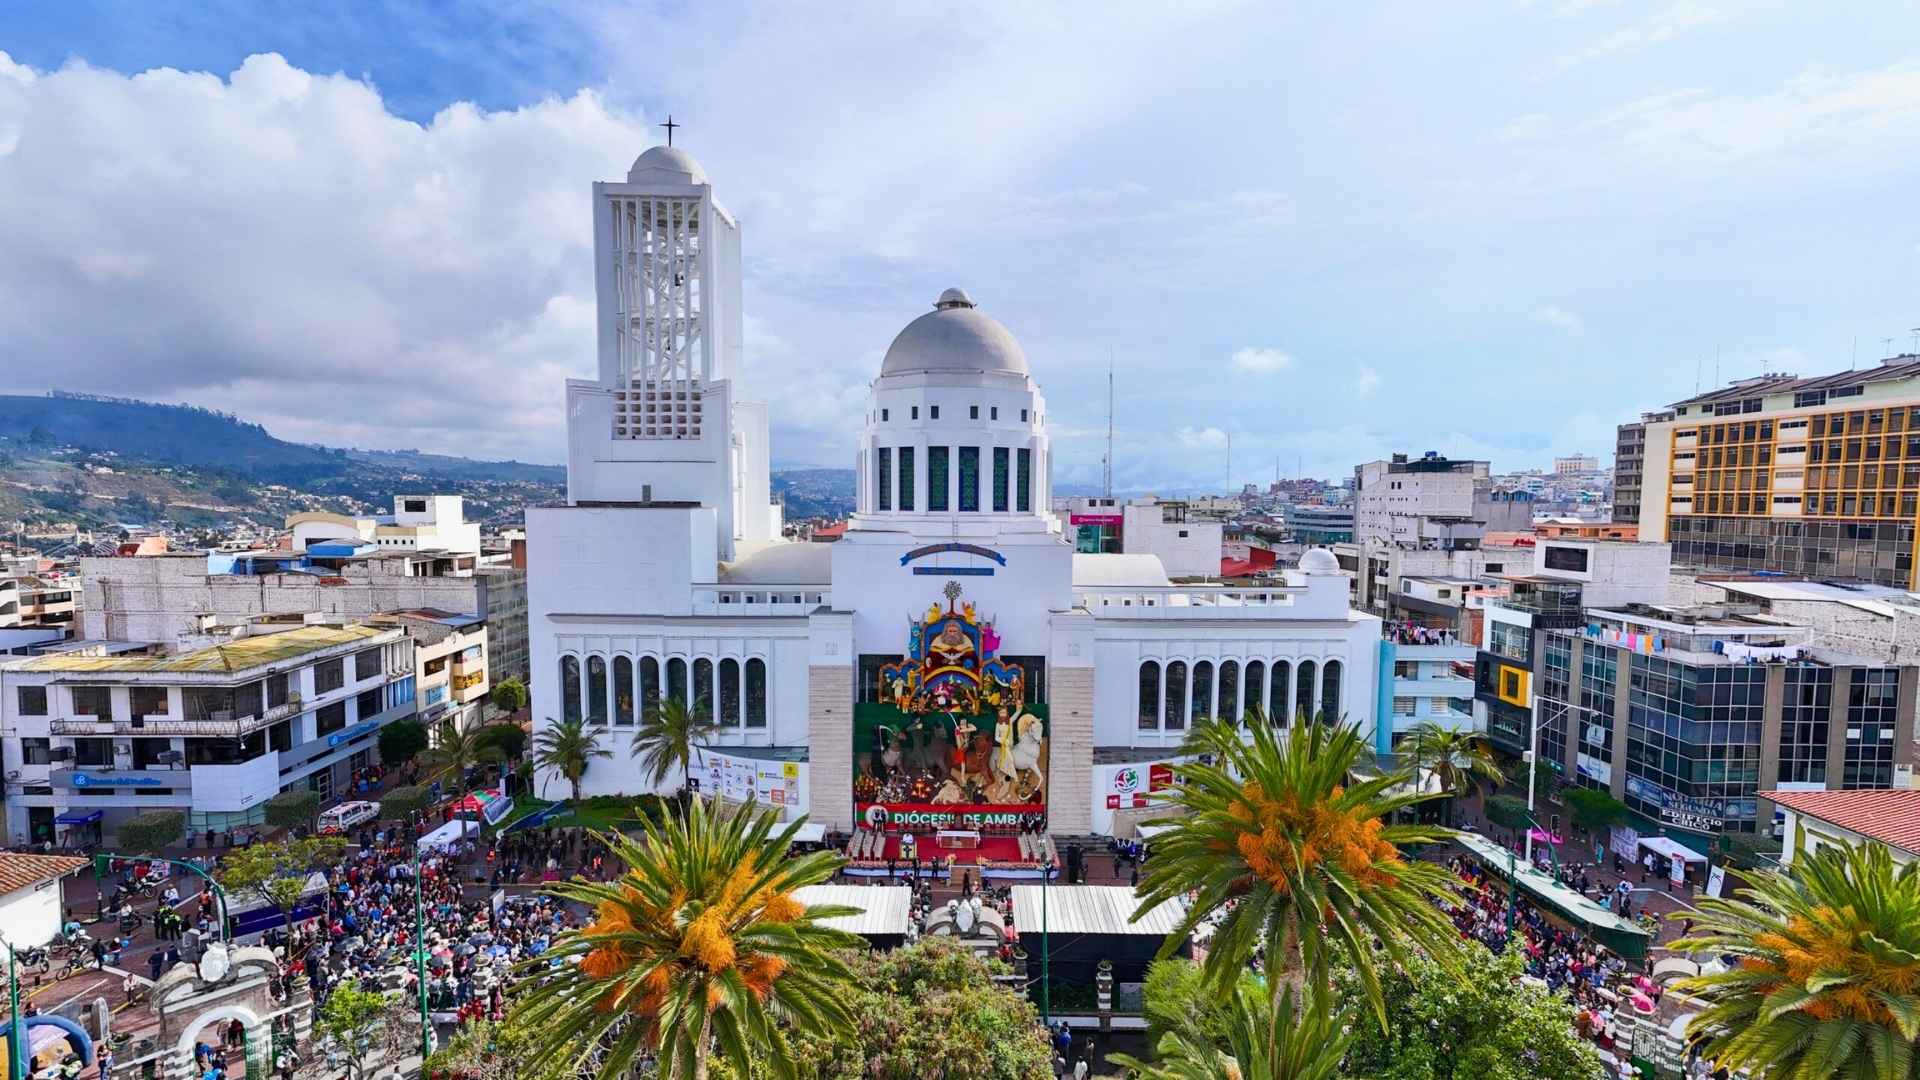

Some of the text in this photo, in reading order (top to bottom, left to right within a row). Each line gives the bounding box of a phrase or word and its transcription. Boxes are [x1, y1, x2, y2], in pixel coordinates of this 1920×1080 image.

[894, 810, 955, 825] DIÓCESI
[963, 813, 981, 825] DE
[1662, 808, 1722, 827] EDIFICIO
[1672, 817, 1710, 831] CHICO
